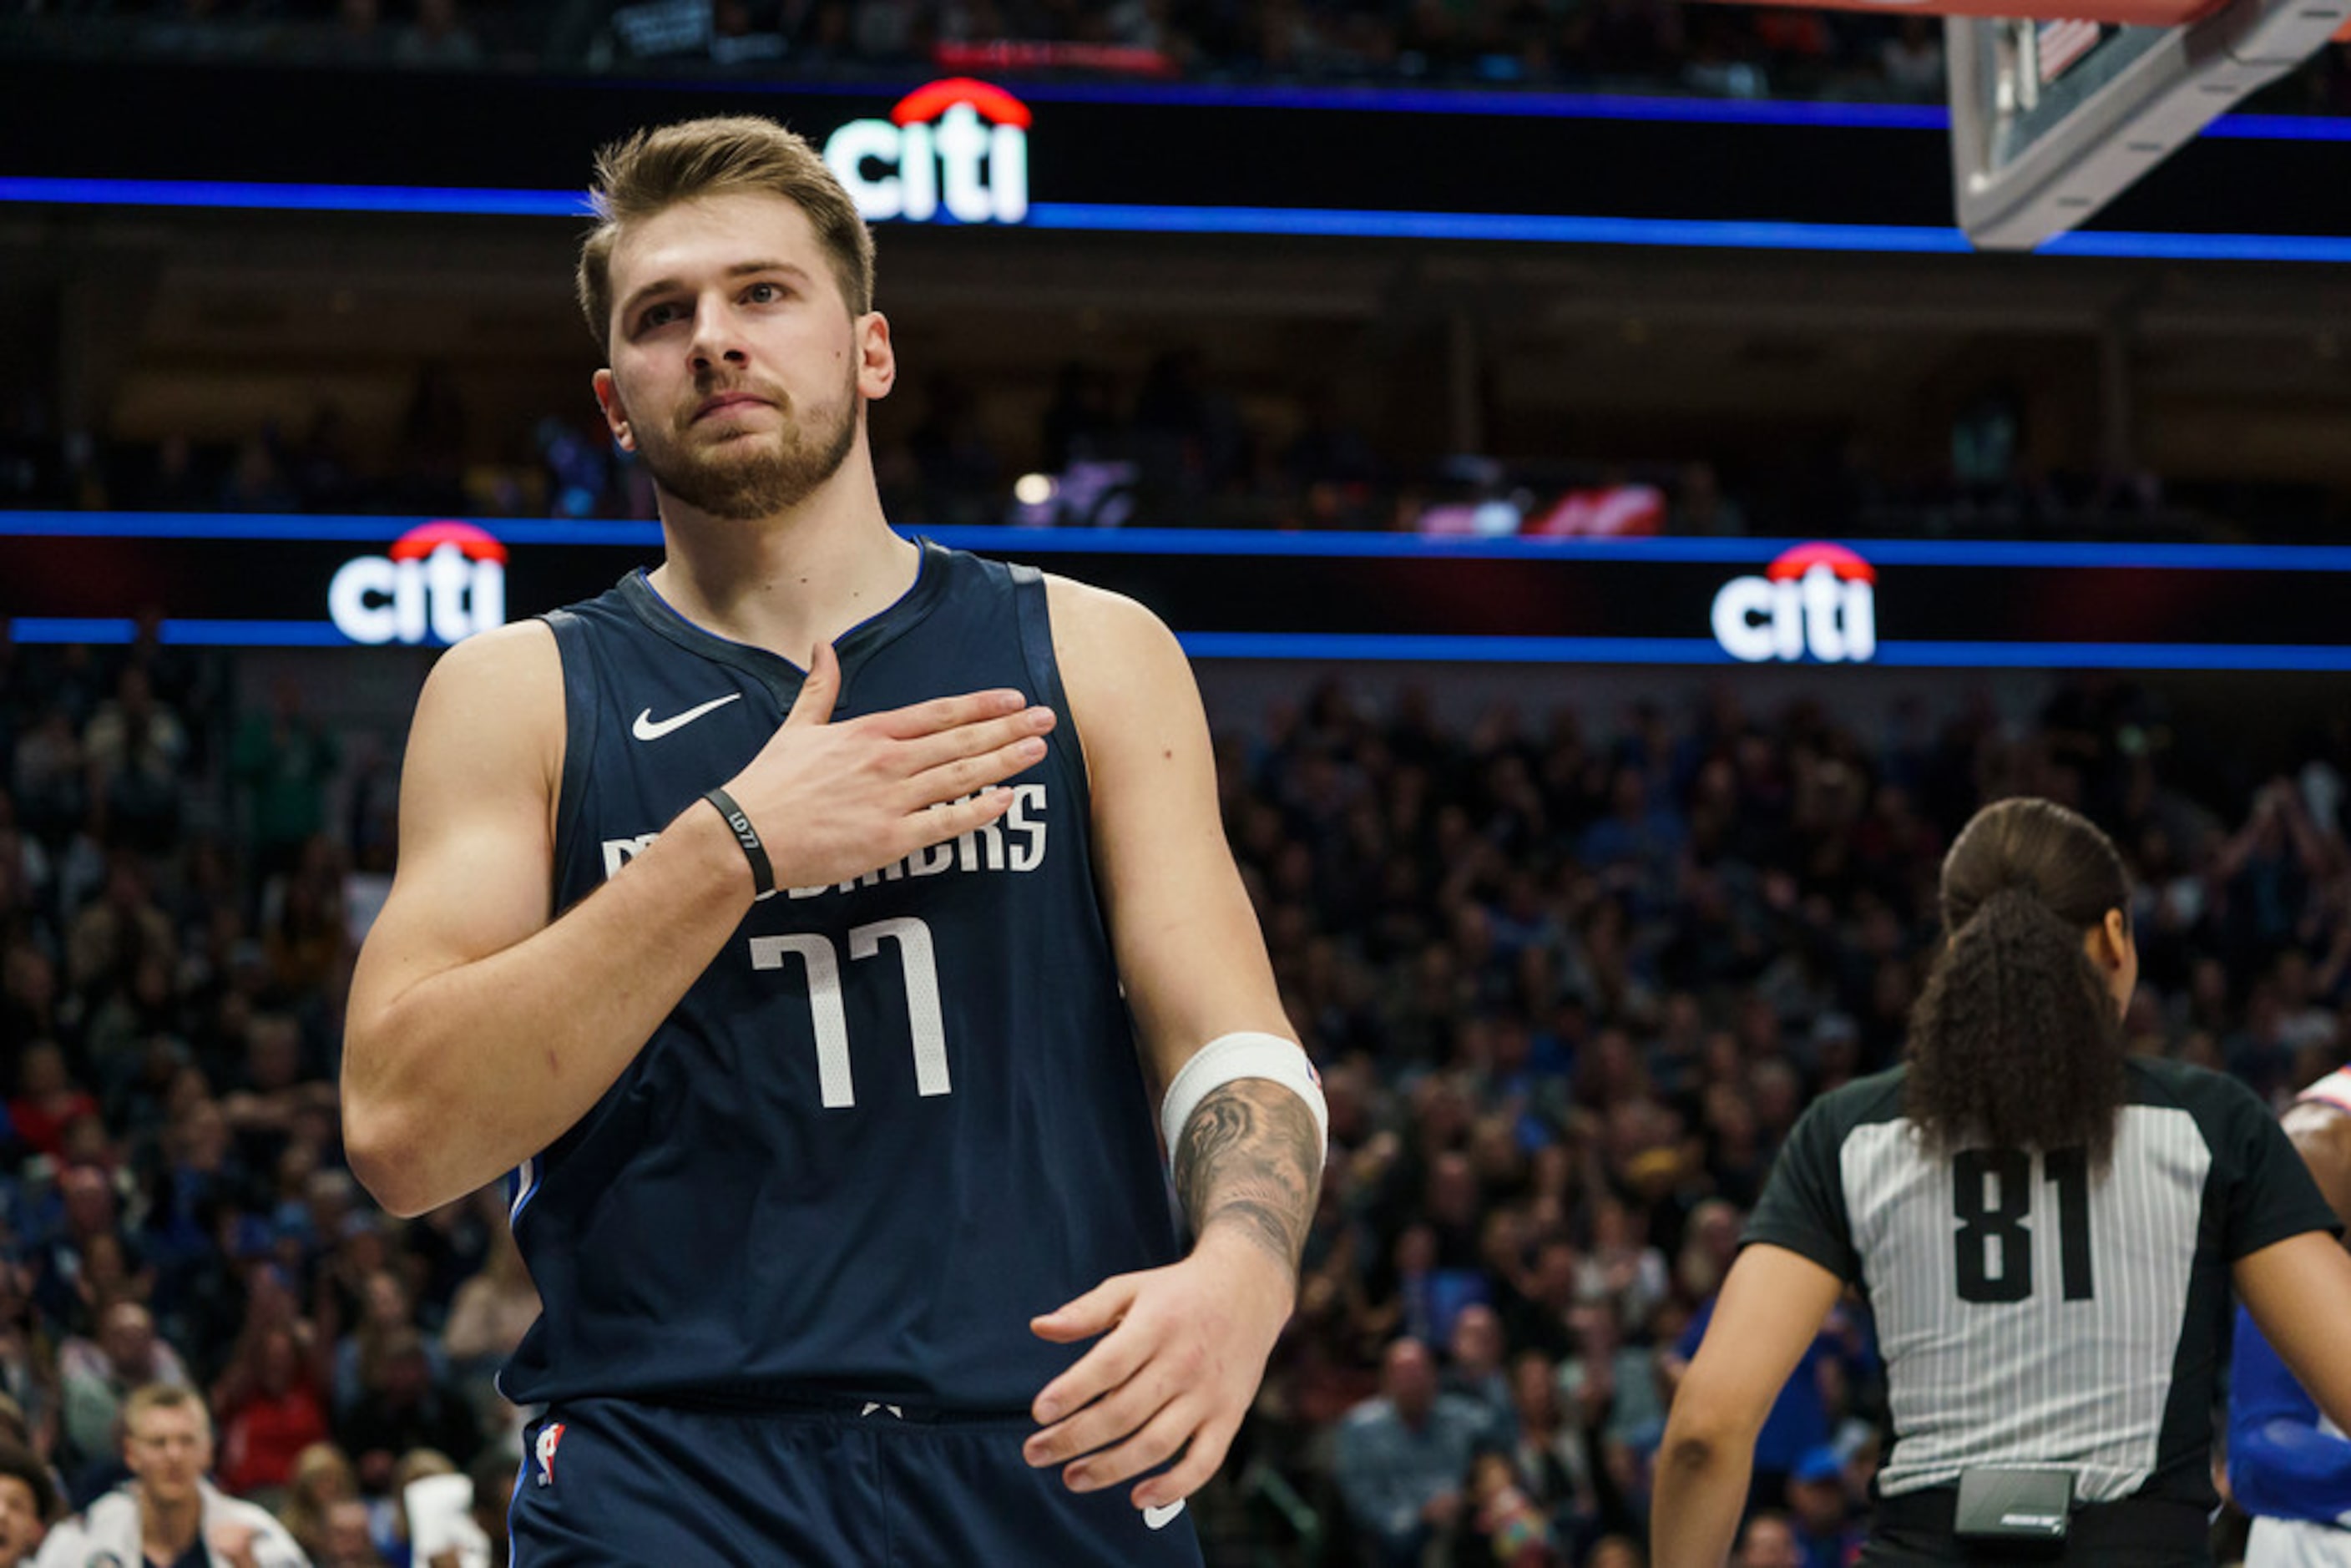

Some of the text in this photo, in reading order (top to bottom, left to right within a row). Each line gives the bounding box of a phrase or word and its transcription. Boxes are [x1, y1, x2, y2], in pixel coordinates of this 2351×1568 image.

[823, 100, 1029, 224] citi
[329, 541, 506, 645] citi
[1711, 561, 1876, 662] citi
[748, 916, 953, 1109] 77
[1953, 1146, 2094, 1304] 81
